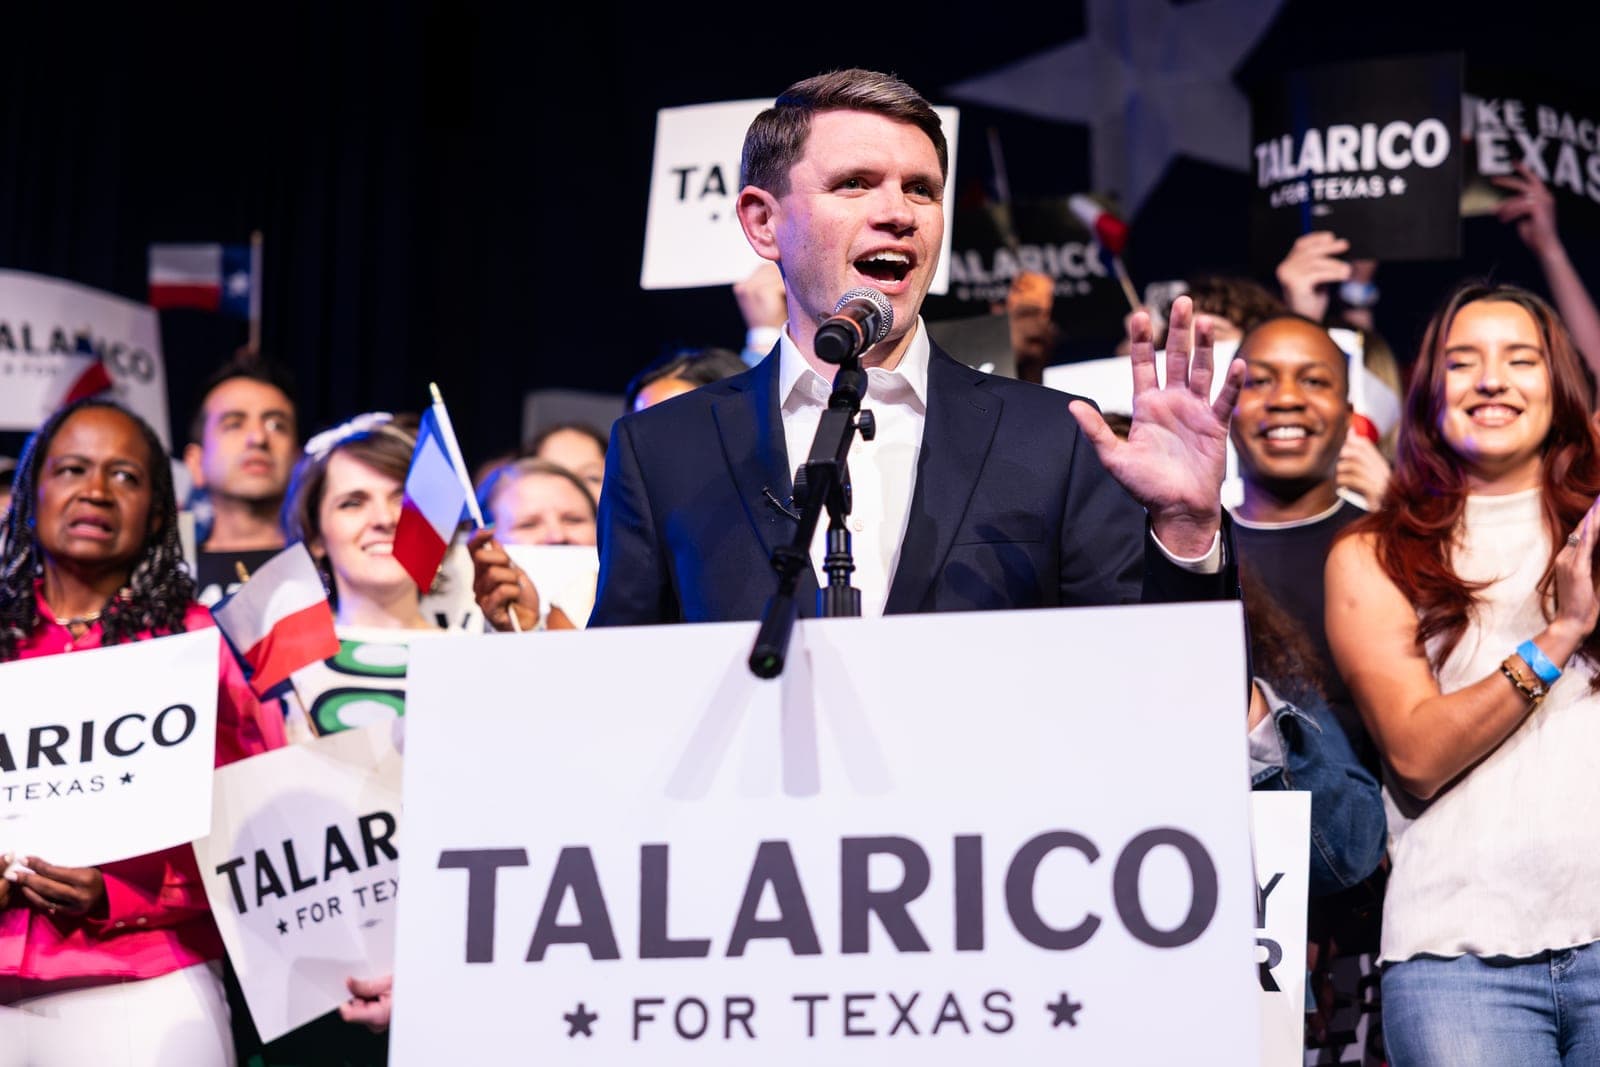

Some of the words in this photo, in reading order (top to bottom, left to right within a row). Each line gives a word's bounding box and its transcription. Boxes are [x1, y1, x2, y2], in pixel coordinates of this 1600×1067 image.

[1256, 117, 1450, 188] TALARICO
[1538, 104, 1600, 152] BAC
[1312, 175, 1385, 201] TEXAS
[0, 321, 155, 384] ALAICO
[2, 775, 105, 802] TEXAS
[296, 896, 342, 930] FOR
[437, 827, 1219, 963] TALARICO
[632, 996, 757, 1041] FOR
[791, 990, 1016, 1037] TEXAS
